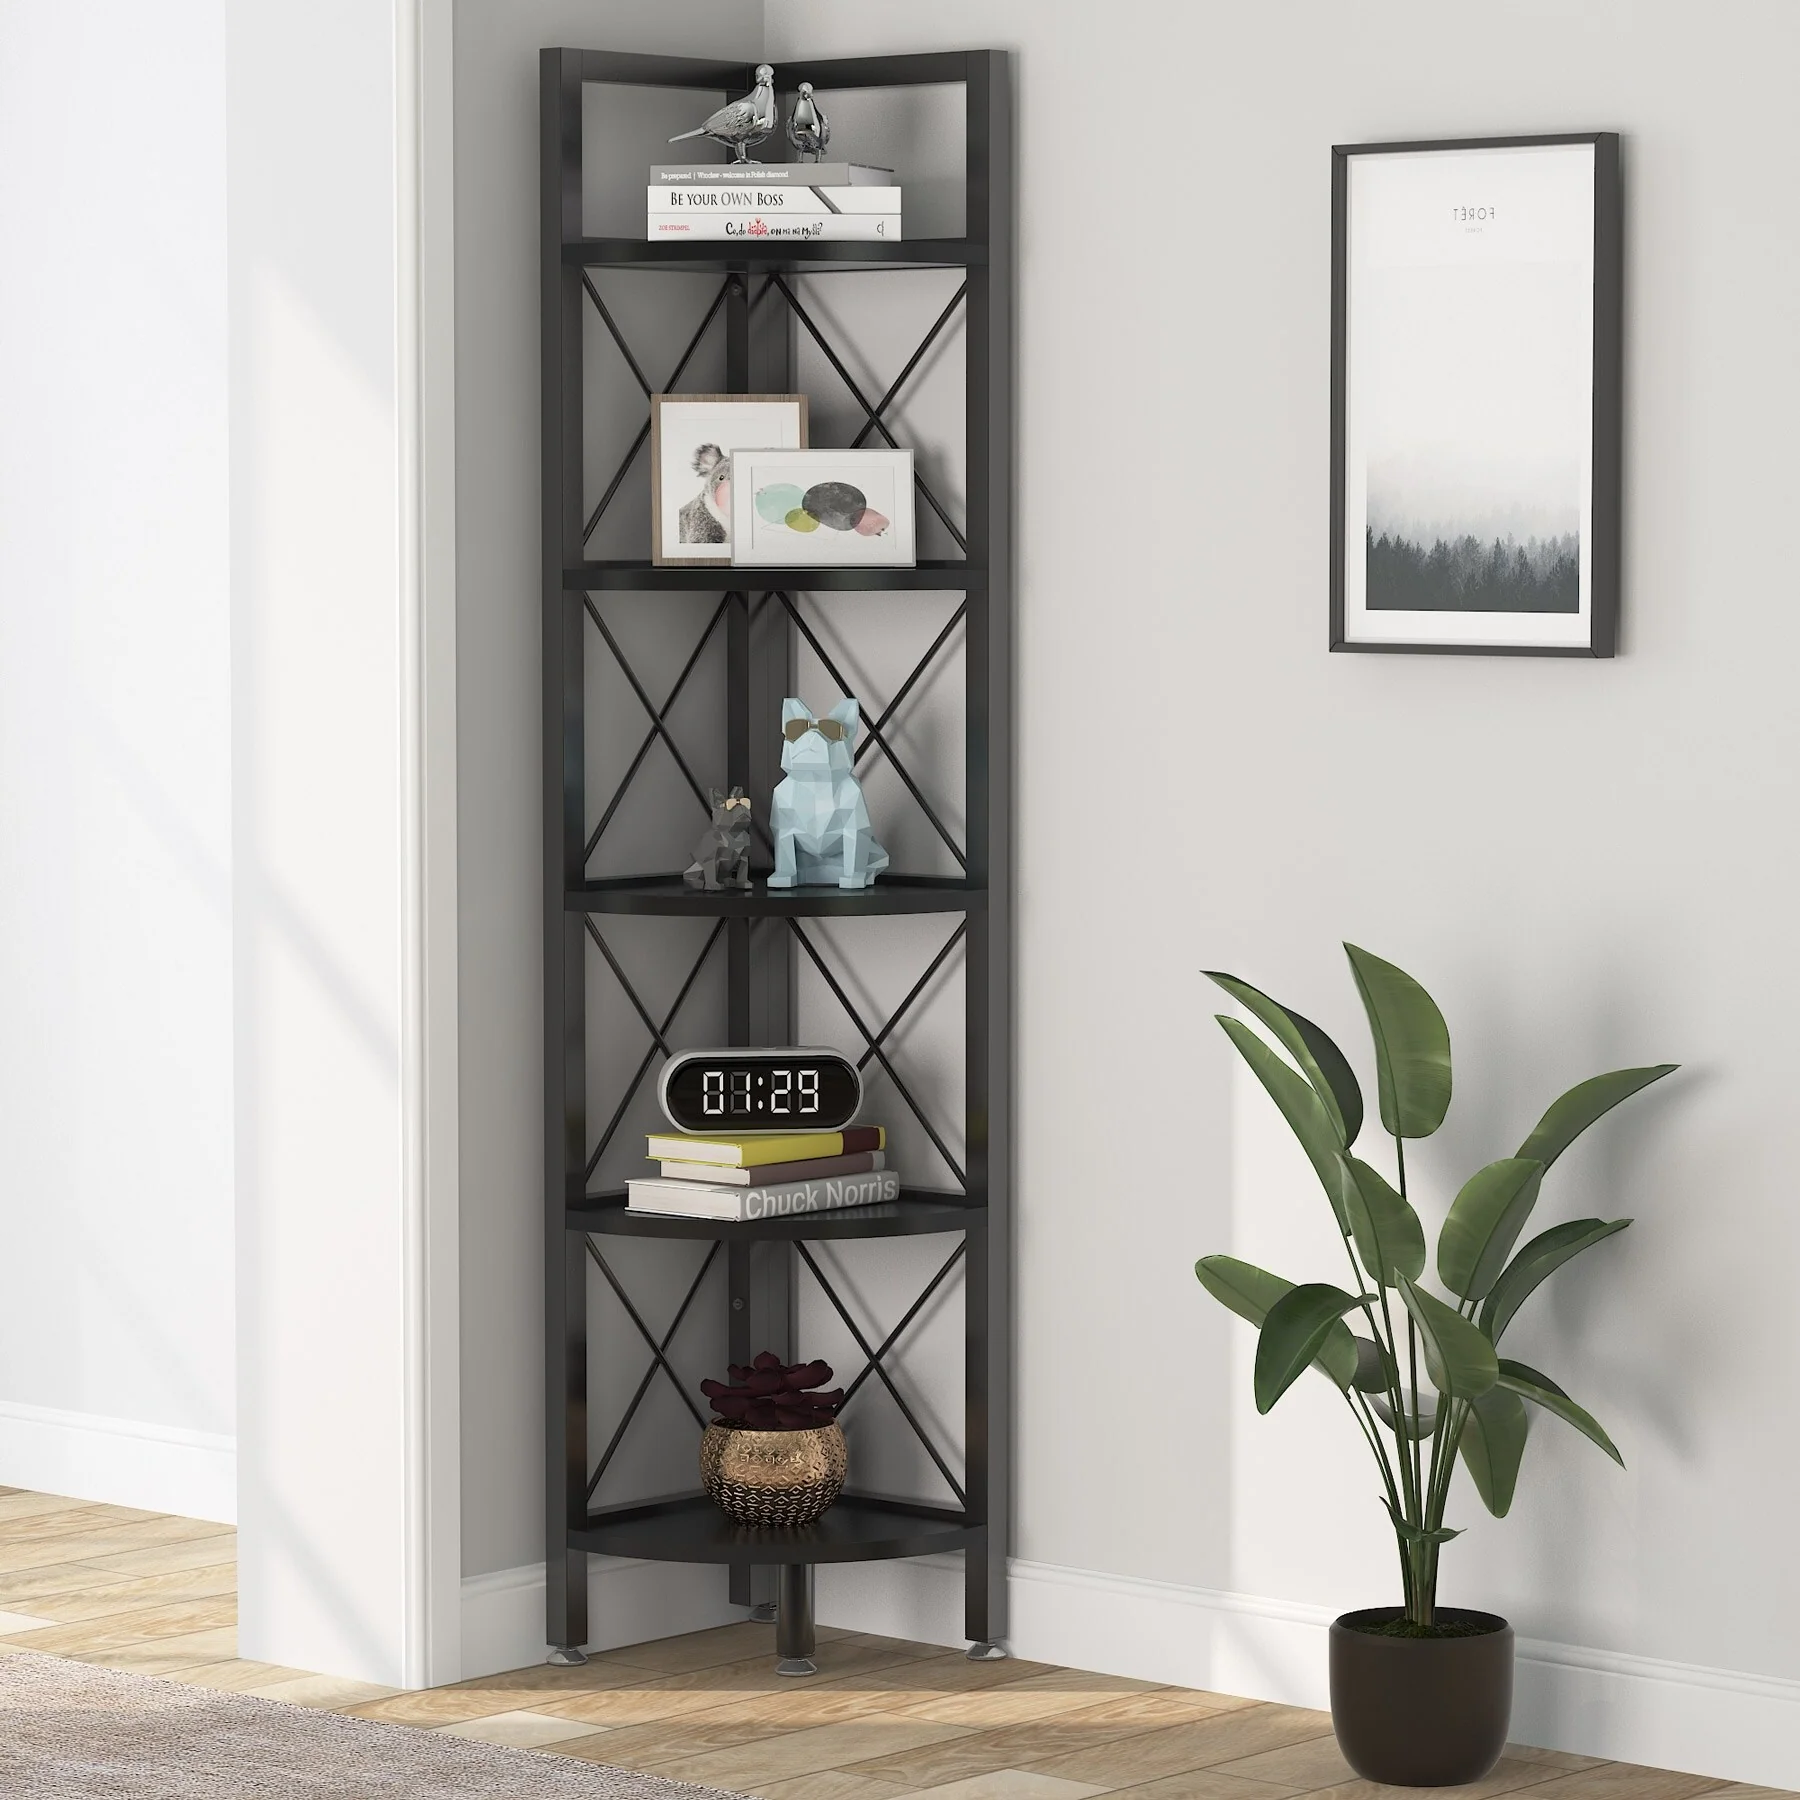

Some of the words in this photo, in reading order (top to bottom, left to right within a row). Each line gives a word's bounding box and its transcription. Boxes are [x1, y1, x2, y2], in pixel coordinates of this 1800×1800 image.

[668, 172, 692, 181] prepared
[722, 171, 746, 179] welcome
[766, 170, 789, 178] diamond
[671, 192, 683, 206] BE
[687, 193, 718, 206] YOUR
[721, 192, 752, 206] OWN
[757, 192, 784, 206] BOSS
[702, 1069, 819, 1115] 01:29
[745, 1183, 819, 1219] Chuck
[825, 1175, 896, 1208] Norris
